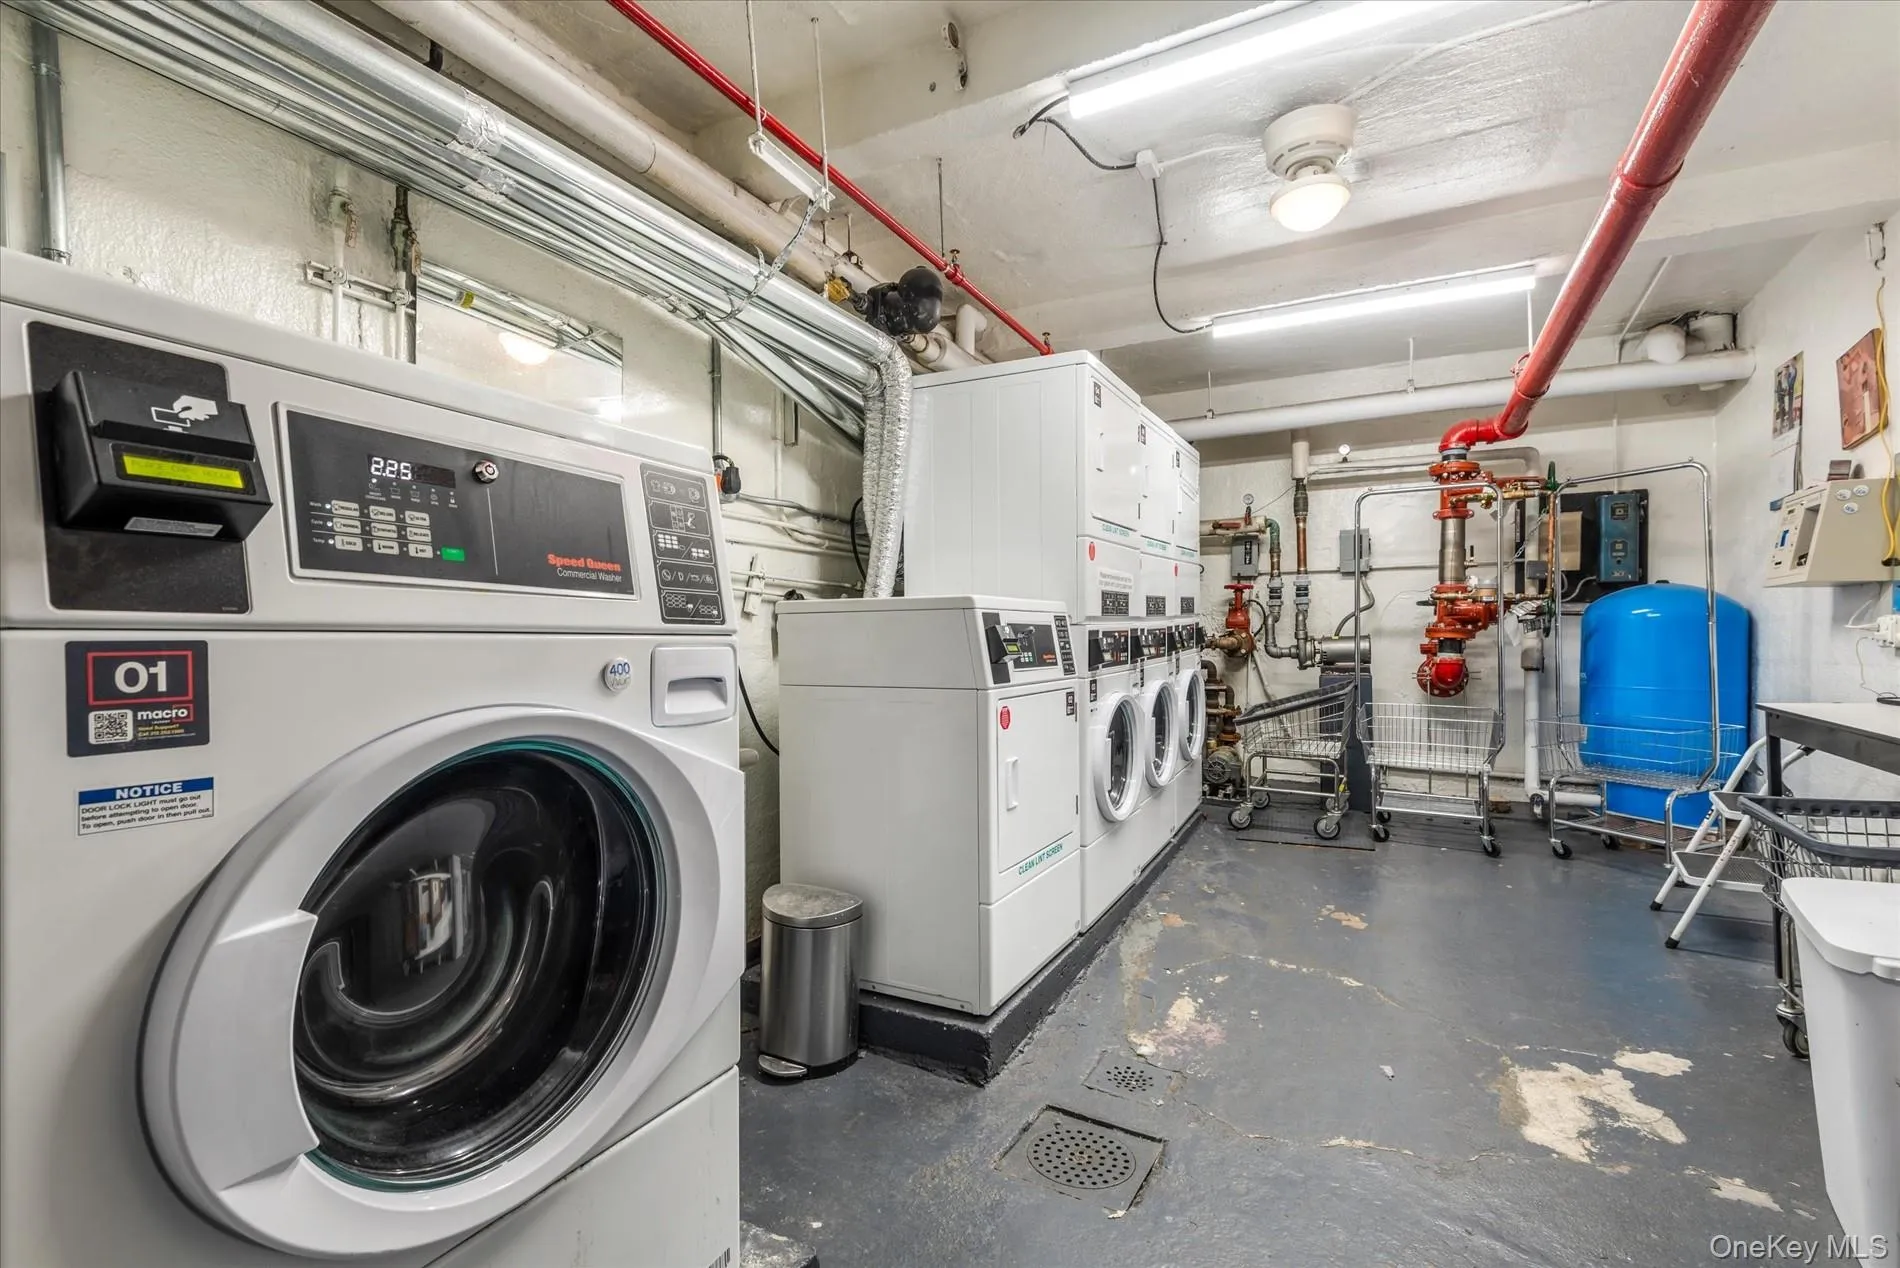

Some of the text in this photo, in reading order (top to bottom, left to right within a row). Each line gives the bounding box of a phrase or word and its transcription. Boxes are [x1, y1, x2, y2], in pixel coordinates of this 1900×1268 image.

[547, 553, 622, 572] Speed Queen
[556, 567, 622, 583] Commercial Washer
[113, 660, 168, 694] 01
[609, 661, 631, 677] 400
[137, 707, 188, 721] macro
[115, 782, 183, 799] NOTICE
[81, 794, 201, 815] DOOR LOCK LIGHT must go out
[81, 813, 107, 822] before
[108, 808, 150, 820] attempting
[160, 804, 179, 813] open
[92, 820, 116, 830] open,
[116, 816, 137, 827] push
[137, 813, 156, 823] door
[157, 812, 165, 820] in
[165, 811, 183, 820] then
[182, 808, 198, 818] pull
[1018, 843, 1063, 875] CLEAN LINT SCREEN
